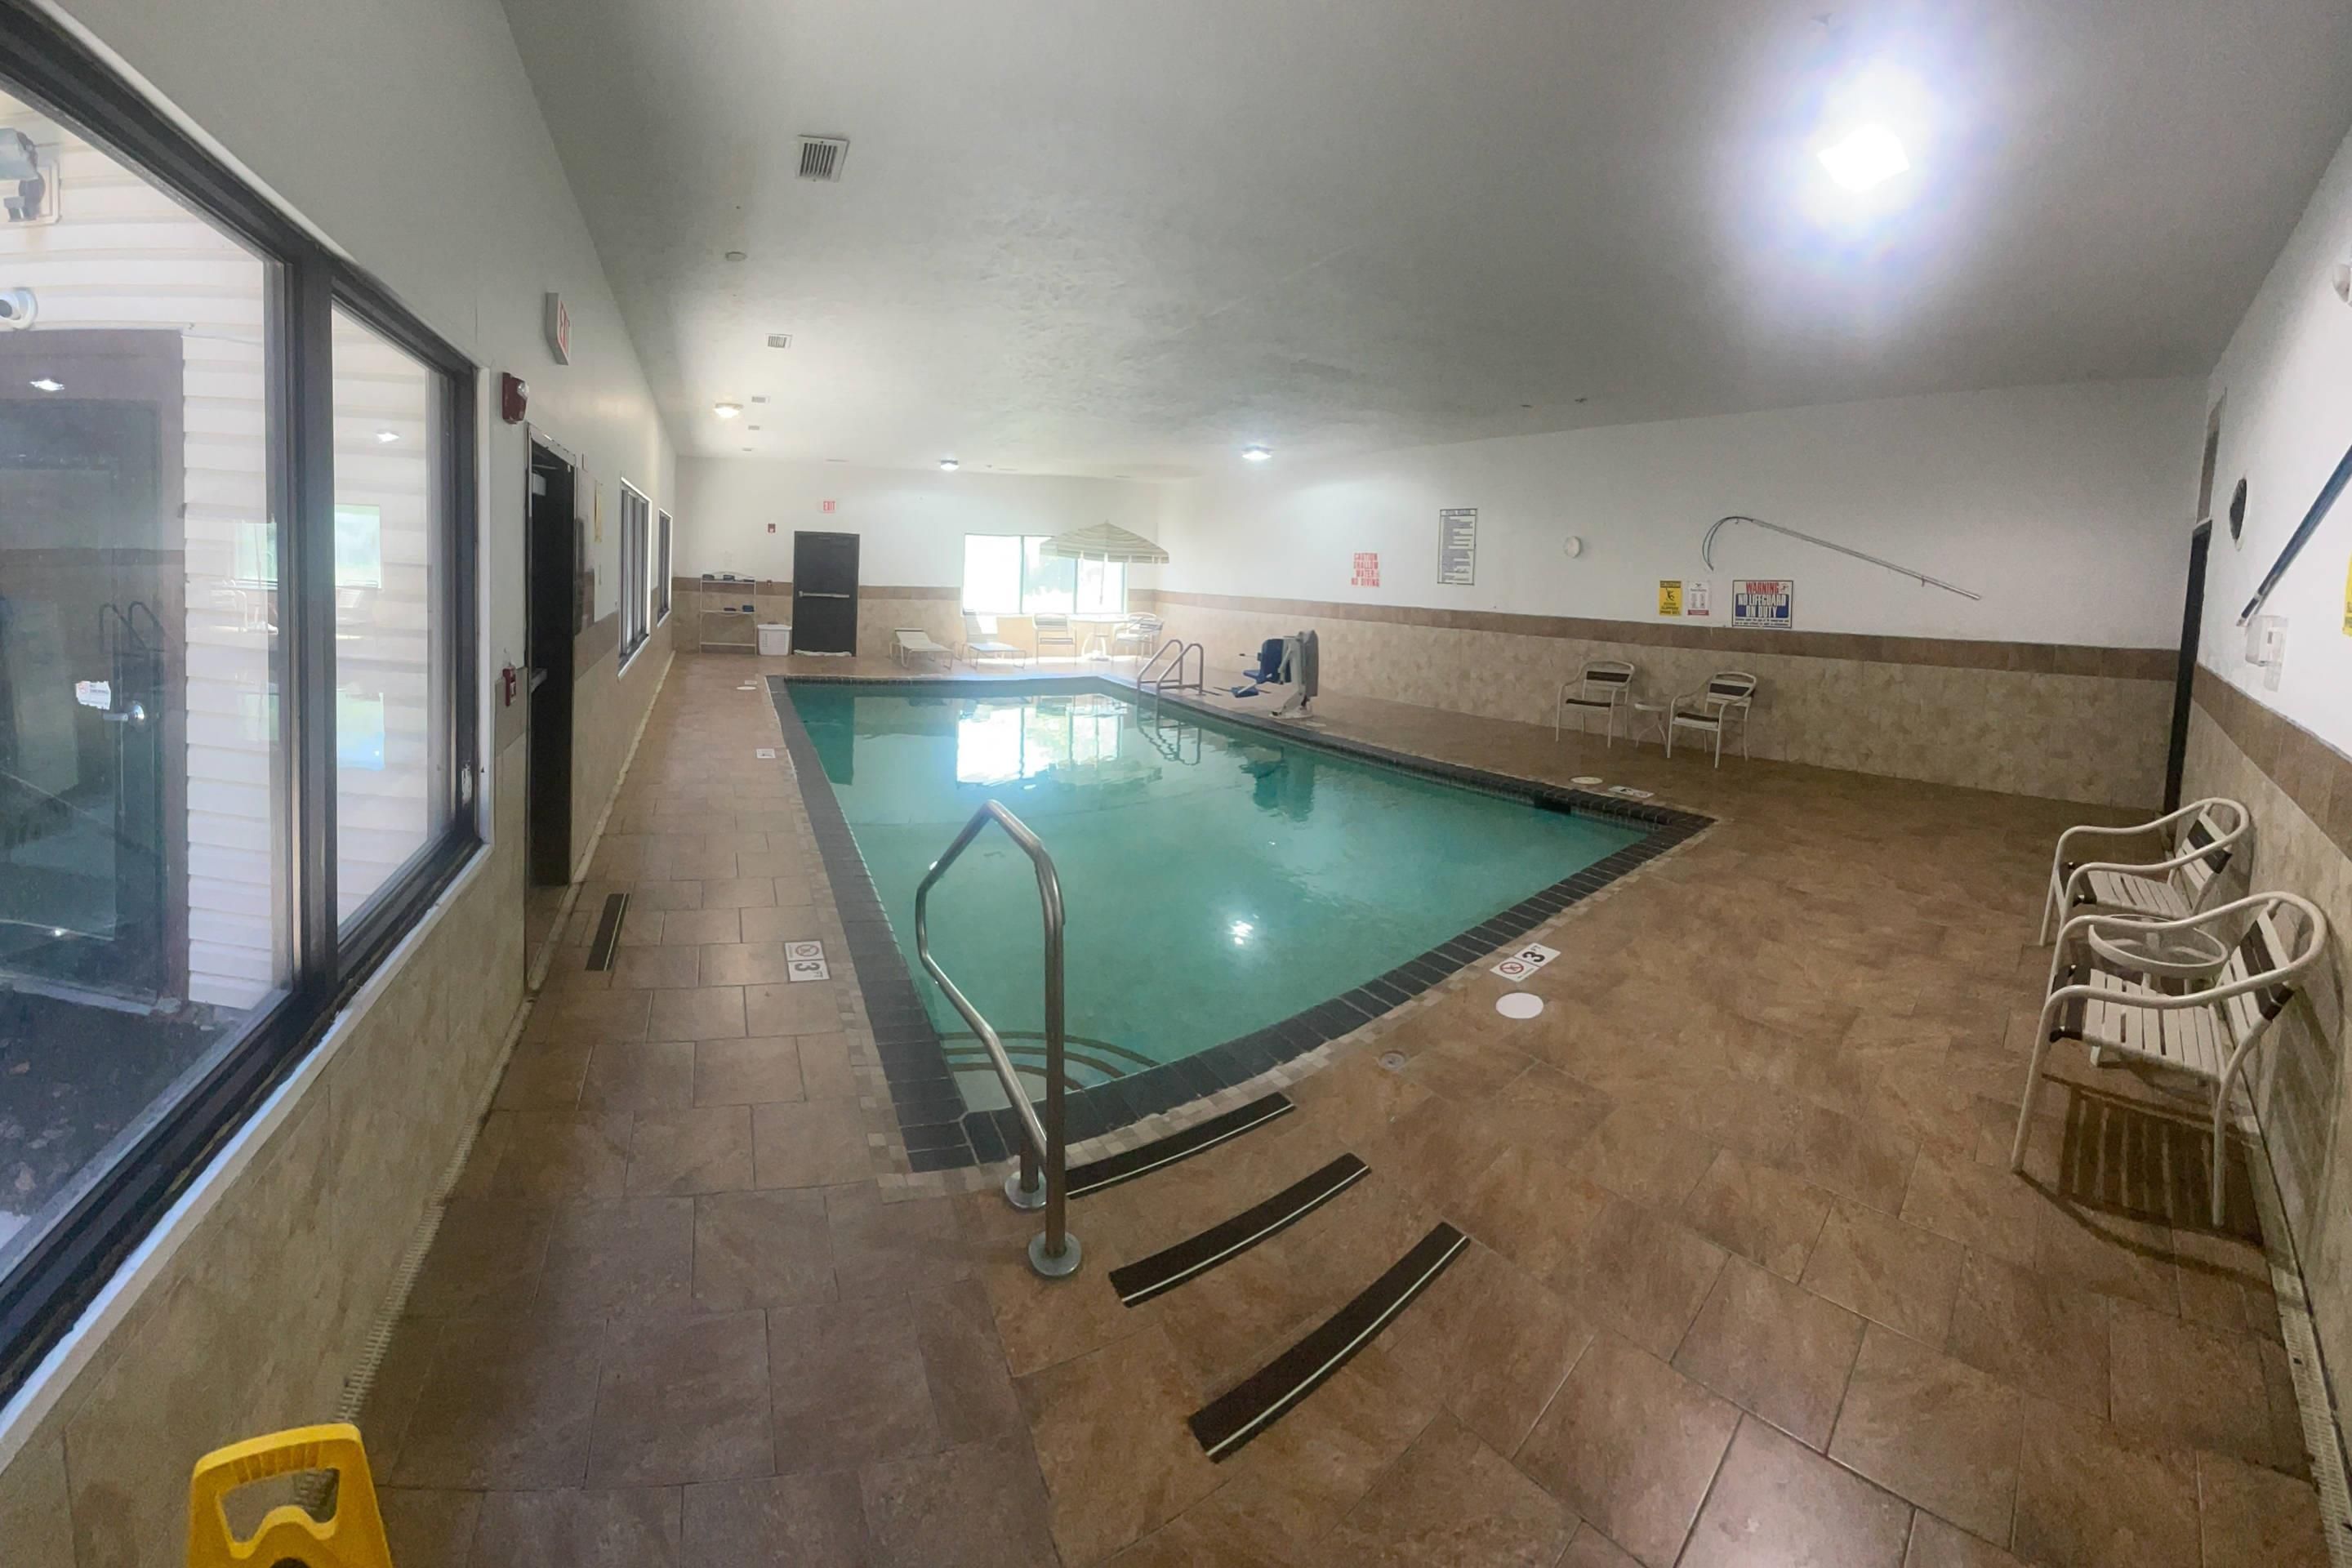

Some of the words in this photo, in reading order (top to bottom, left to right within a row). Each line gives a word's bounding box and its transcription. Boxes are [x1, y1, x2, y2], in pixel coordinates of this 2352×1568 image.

[823, 501, 835, 510] EXIT
[1353, 552, 1378, 560] CAUTION
[1351, 577, 1359, 586] NO
[1361, 577, 1379, 586] DIVING
[1745, 581, 1779, 595] WARNING
[1738, 594, 1748, 606] NO
[1748, 594, 1786, 607] LIFEGUARD
[1745, 605, 1756, 617] ON
[1757, 606, 1778, 618] DUTY
[1521, 951, 1545, 962] 3
[794, 962, 821, 972] 3
